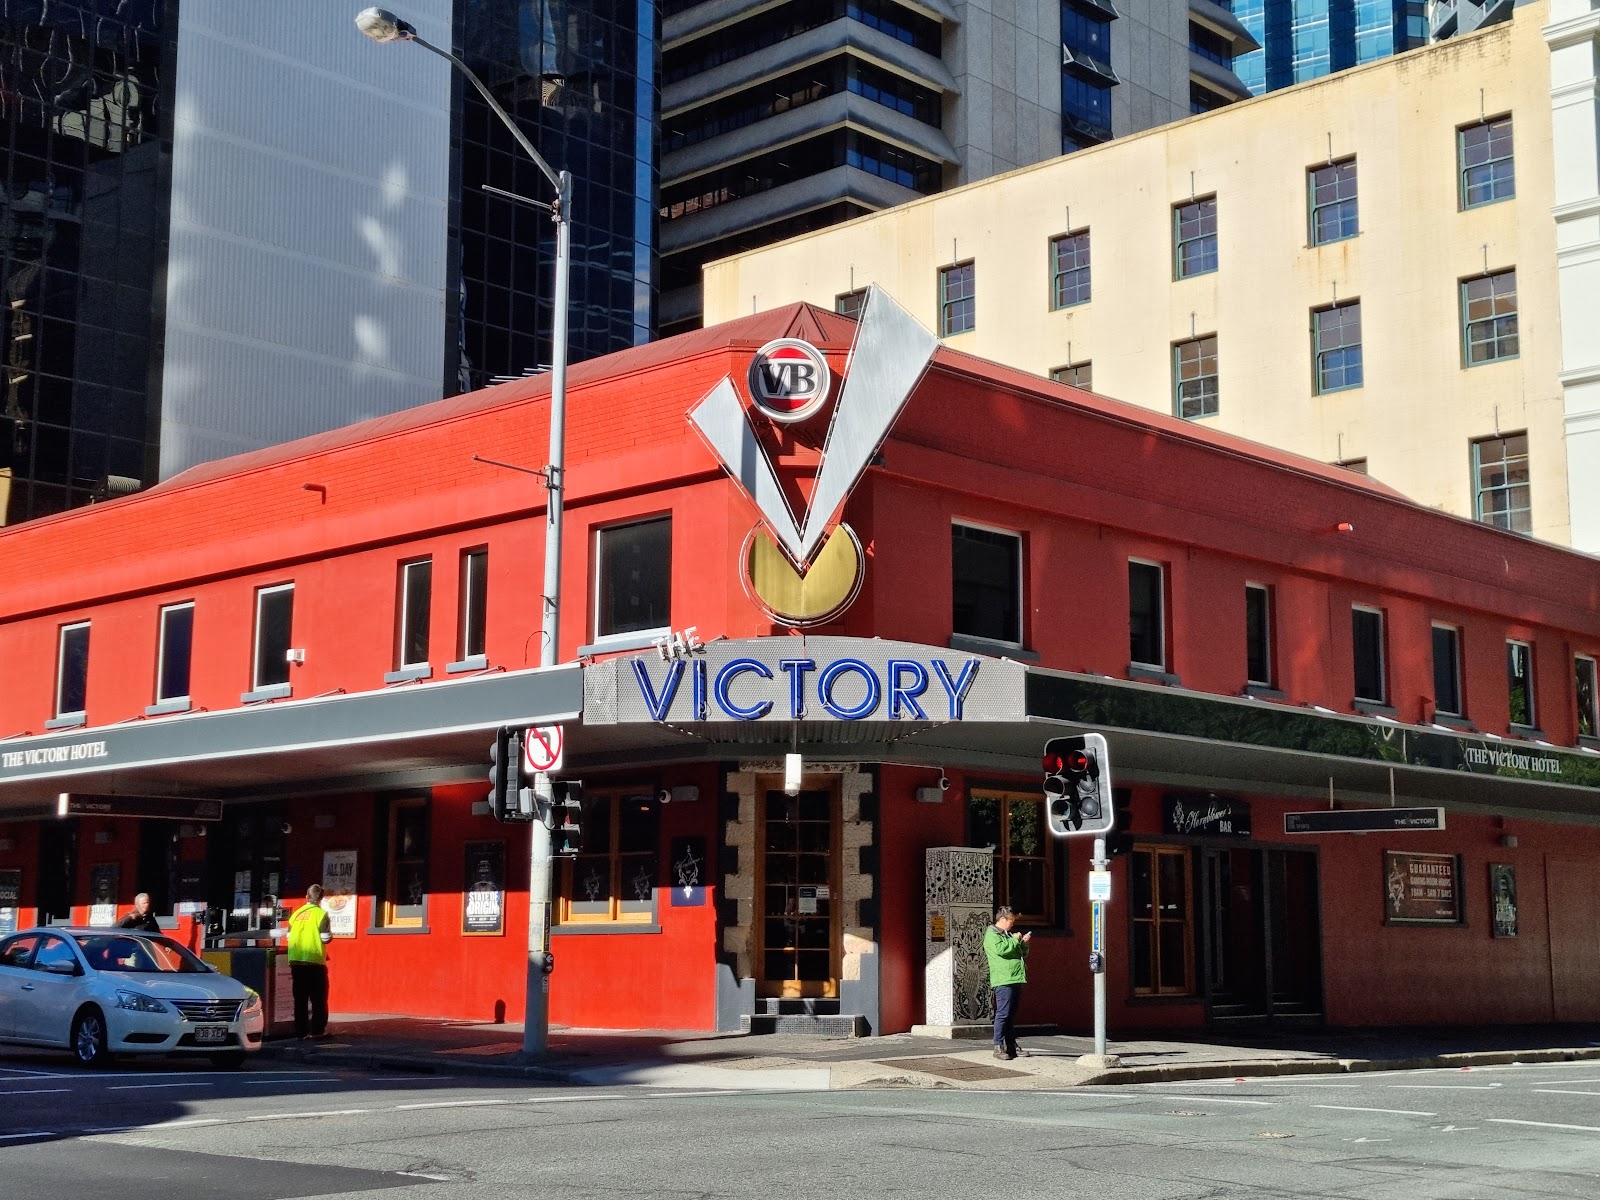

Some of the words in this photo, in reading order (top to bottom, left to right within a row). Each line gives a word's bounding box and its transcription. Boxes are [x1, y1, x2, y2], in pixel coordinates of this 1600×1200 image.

[758, 362, 815, 395] VB
[651, 626, 700, 660] THE
[631, 657, 981, 721] VICTORY
[2, 751, 24, 767] THE
[25, 745, 70, 765] VICTORY
[70, 741, 108, 760] HOTEL
[1467, 747, 1488, 764] THE
[1489, 750, 1531, 770] VICTORY
[1531, 756, 1562, 774] HOTEL
[1220, 820, 1232, 833] BAR
[1409, 817, 1436, 825] VICTORY
[327, 862, 338, 876] ALL
[340, 862, 354, 876] DAY
[1409, 863, 1451, 876] GUARANTEED
[0, 891, 17, 900] OCIAL
[469, 891, 490, 902] STATE
[490, 891, 499, 902] OF
[468, 901, 498, 915] ORIGIN
[340, 915, 352, 924] WEEK
